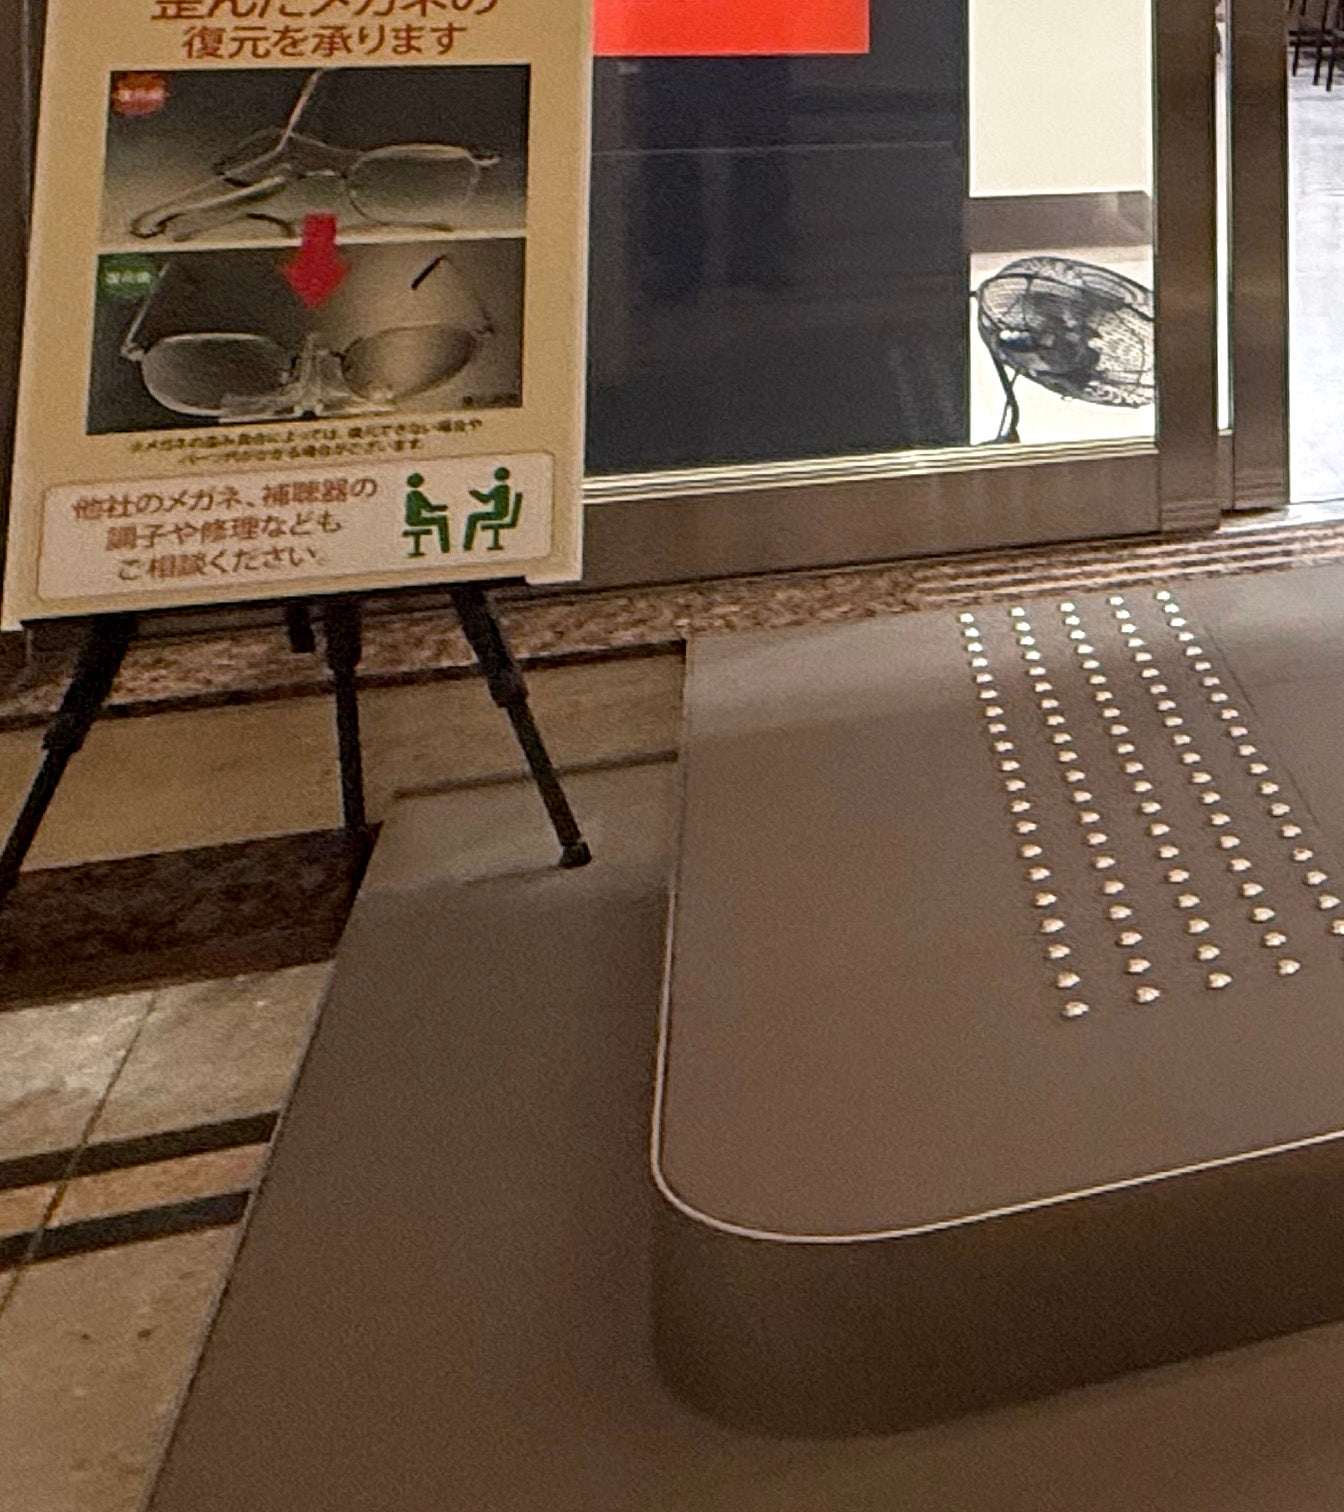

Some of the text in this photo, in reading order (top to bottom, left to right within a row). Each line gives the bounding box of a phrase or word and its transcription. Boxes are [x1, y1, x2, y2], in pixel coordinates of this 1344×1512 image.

[181, 22, 468, 60] 復元を承ります
